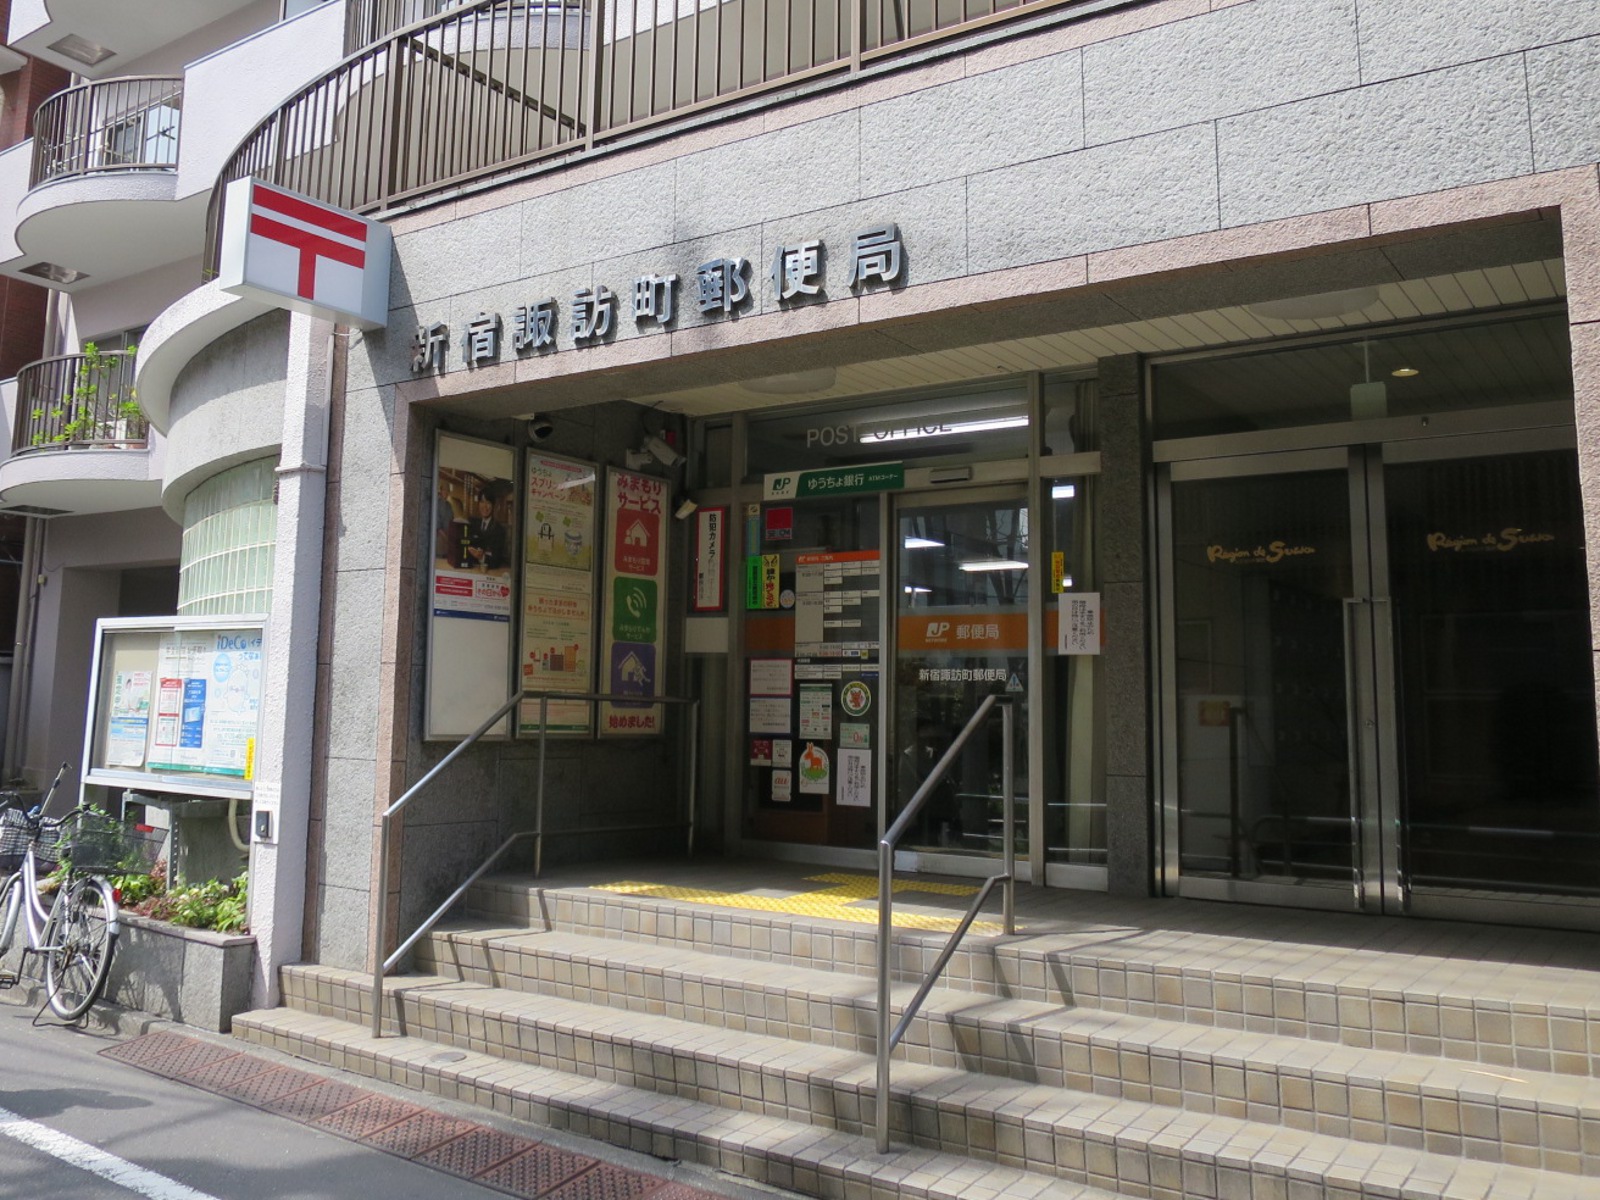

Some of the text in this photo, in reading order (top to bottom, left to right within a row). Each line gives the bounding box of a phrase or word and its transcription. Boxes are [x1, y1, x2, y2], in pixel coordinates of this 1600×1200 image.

[410, 222, 902, 373] 新宿諏訪町郵便局
[806, 423, 861, 449] POST
[616, 474, 662, 494] みまもり
[807, 473, 865, 490] ゆうちょ銀行
[617, 493, 662, 514] サービス
[926, 622, 950, 637] JP
[956, 623, 999, 640] 郵便局
[216, 634, 247, 650] iDeCo
[918, 668, 1007, 682] 新宿諏訪町郵便局
